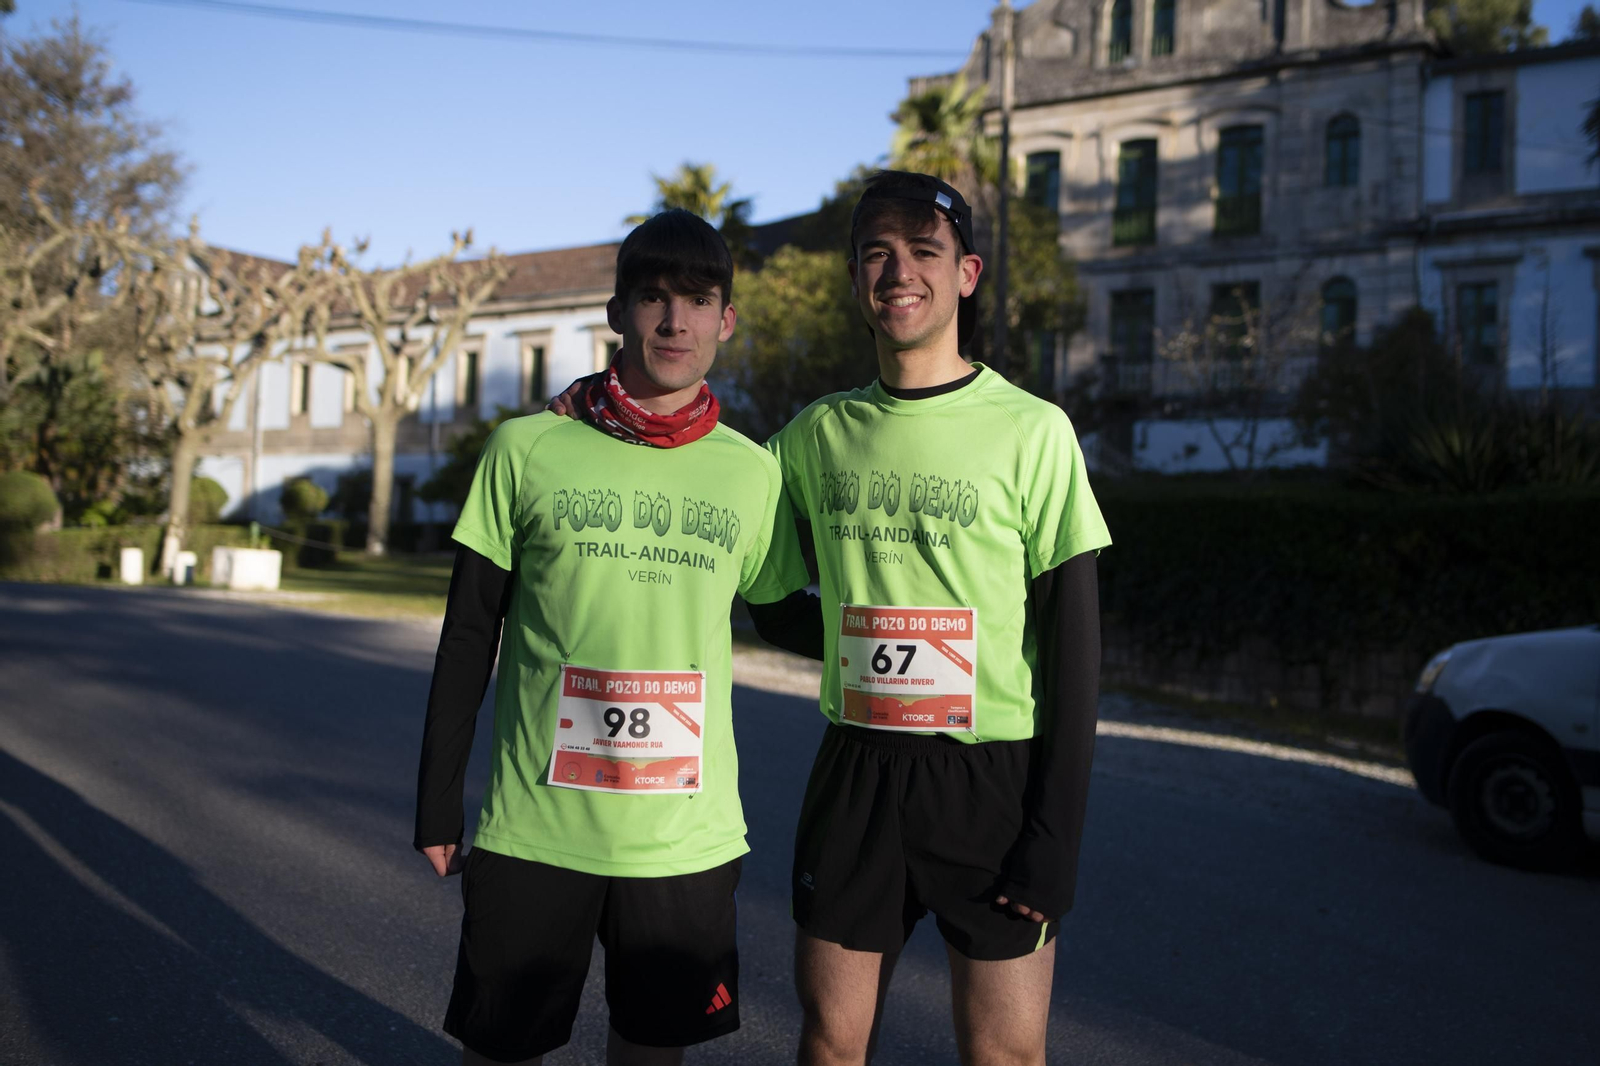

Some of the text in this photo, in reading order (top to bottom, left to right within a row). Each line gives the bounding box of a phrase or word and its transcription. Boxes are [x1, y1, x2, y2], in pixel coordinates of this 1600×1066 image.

[819, 470, 979, 528] POZO DO DEMO
[553, 488, 741, 554] POZO DO DEMO
[829, 525, 951, 550] TRAIL-ANDAINA
[574, 542, 715, 574] TRAIL-ANDAINA
[865, 550, 904, 565] VERÍN
[628, 569, 672, 585] VERÍN
[846, 614, 967, 631] TRAIL POZO DO DEMO
[871, 644, 917, 675] 67
[570, 674, 696, 694] TRAIL POZO DO DEMO
[859, 675, 876, 684] PABLO
[877, 677, 909, 685] VILLARINO
[603, 707, 651, 739] 98
[593, 737, 612, 748] JAVIER
[613, 740, 649, 749] VAAMONDE
[650, 741, 663, 749] RUA
